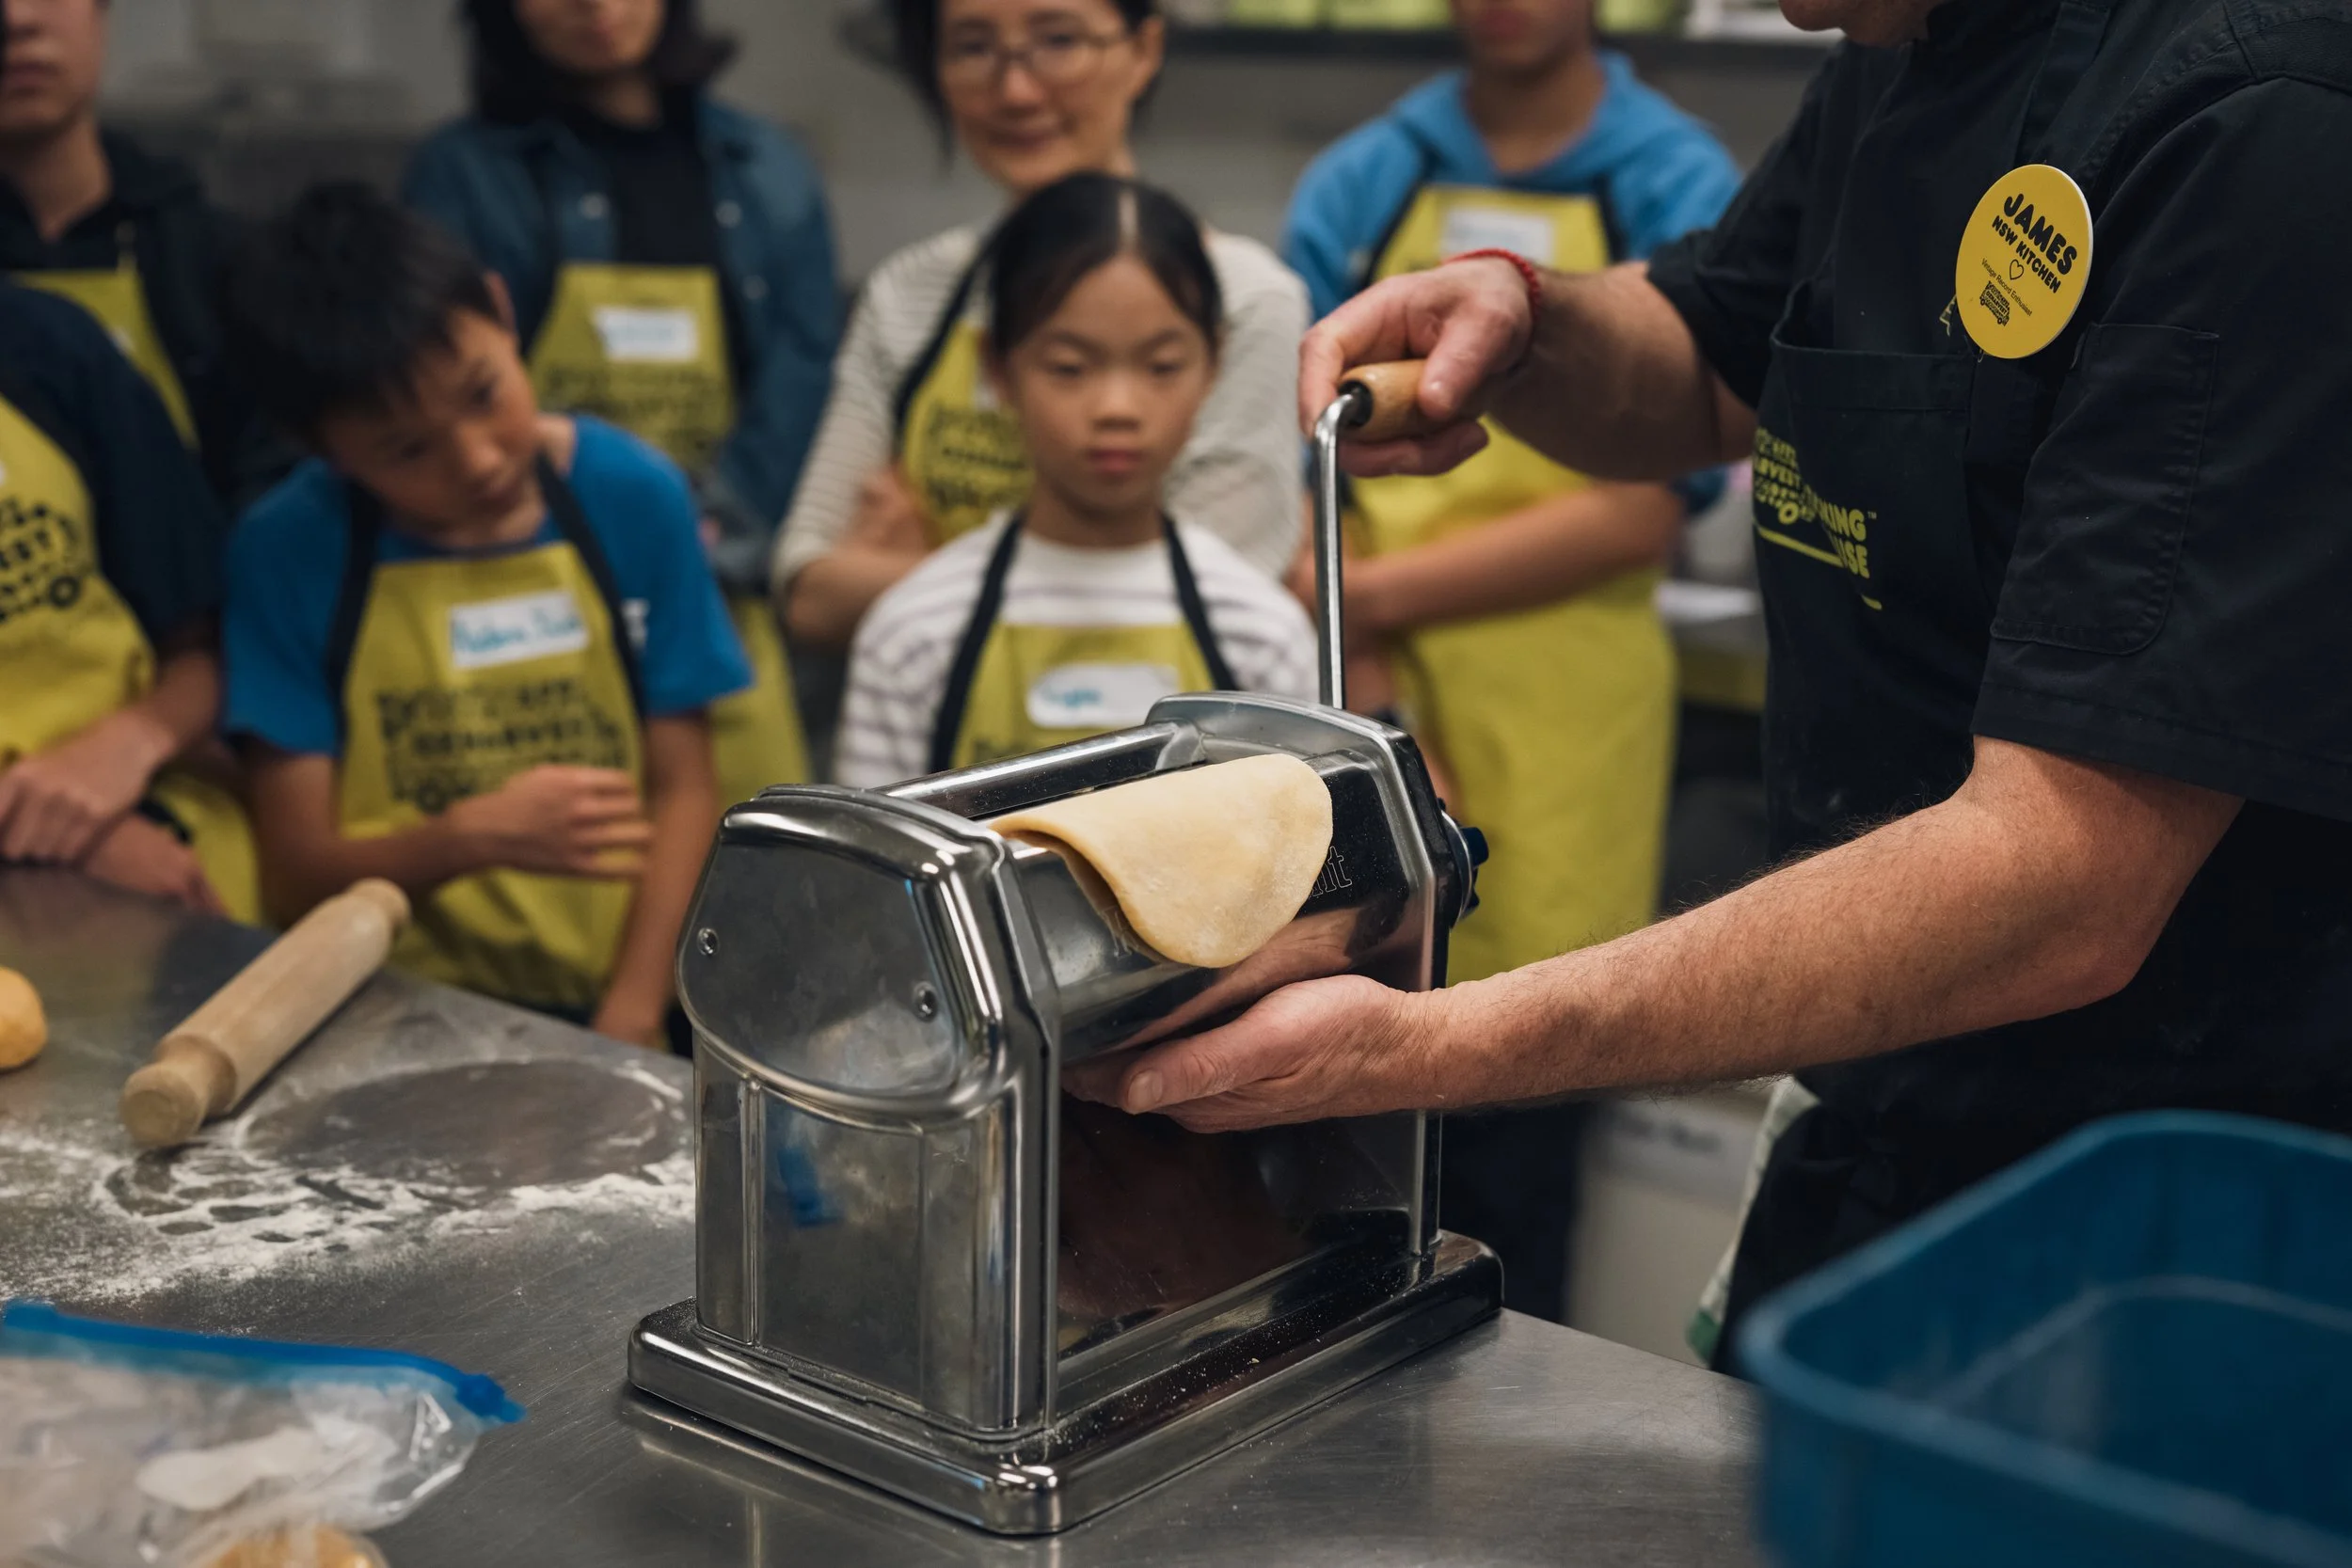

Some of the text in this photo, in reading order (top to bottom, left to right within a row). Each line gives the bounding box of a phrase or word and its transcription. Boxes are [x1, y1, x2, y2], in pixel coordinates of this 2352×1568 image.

[1992, 214, 2018, 245] NSW
[2015, 241, 2061, 293] KITCHEN
[2003, 193, 2077, 276] JAMES
[1995, 274, 2011, 294] Record
[2010, 292, 2032, 317] Enthusiast
